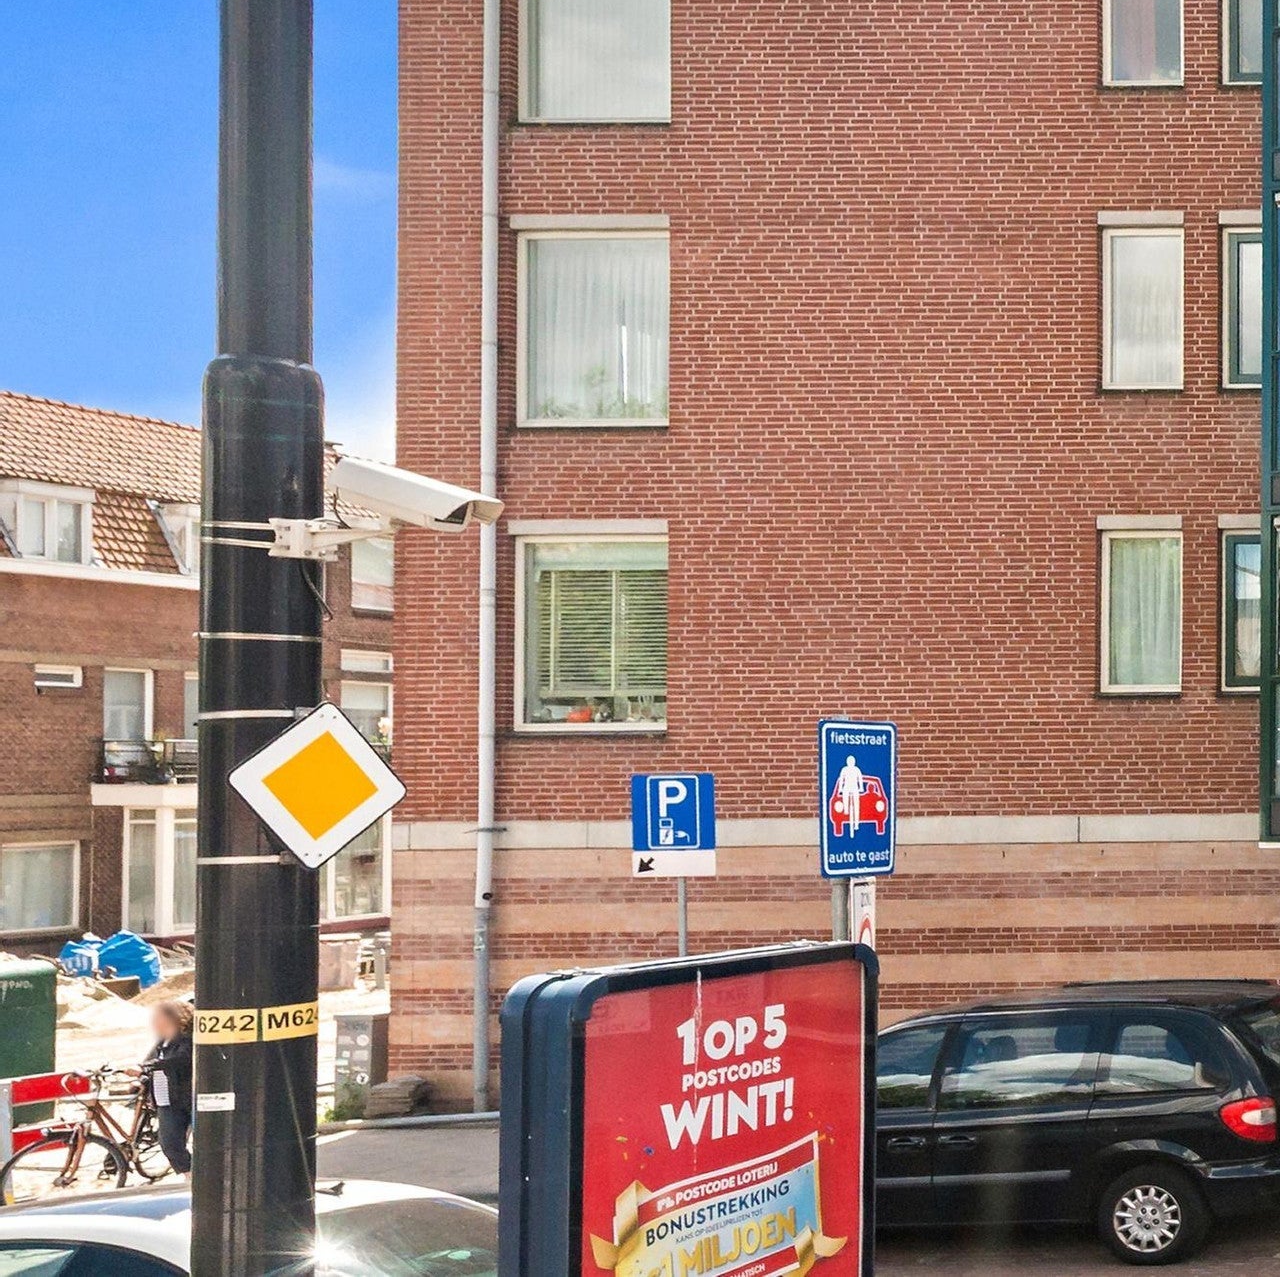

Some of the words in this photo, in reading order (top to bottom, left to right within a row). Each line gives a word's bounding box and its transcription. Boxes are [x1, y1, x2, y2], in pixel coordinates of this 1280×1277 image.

[830, 731, 887, 746] fietsstraat
[658, 780, 688, 818] P
[829, 849, 854, 864] auto
[855, 850, 866, 863] te
[868, 849, 891, 865] gast
[195, 1015, 256, 1033] 6242
[703, 1016, 758, 1061] OP
[763, 1003, 788, 1050] 5
[681, 1056, 782, 1093] POSTCODES
[660, 1077, 795, 1151] WINT!
[675, 1178, 735, 1205] POSTCODE
[737, 1161, 778, 1189] LOTERIJ
[646, 1179, 790, 1247] BONUSTREKKING
[678, 1206, 797, 1277] MILJOEN
